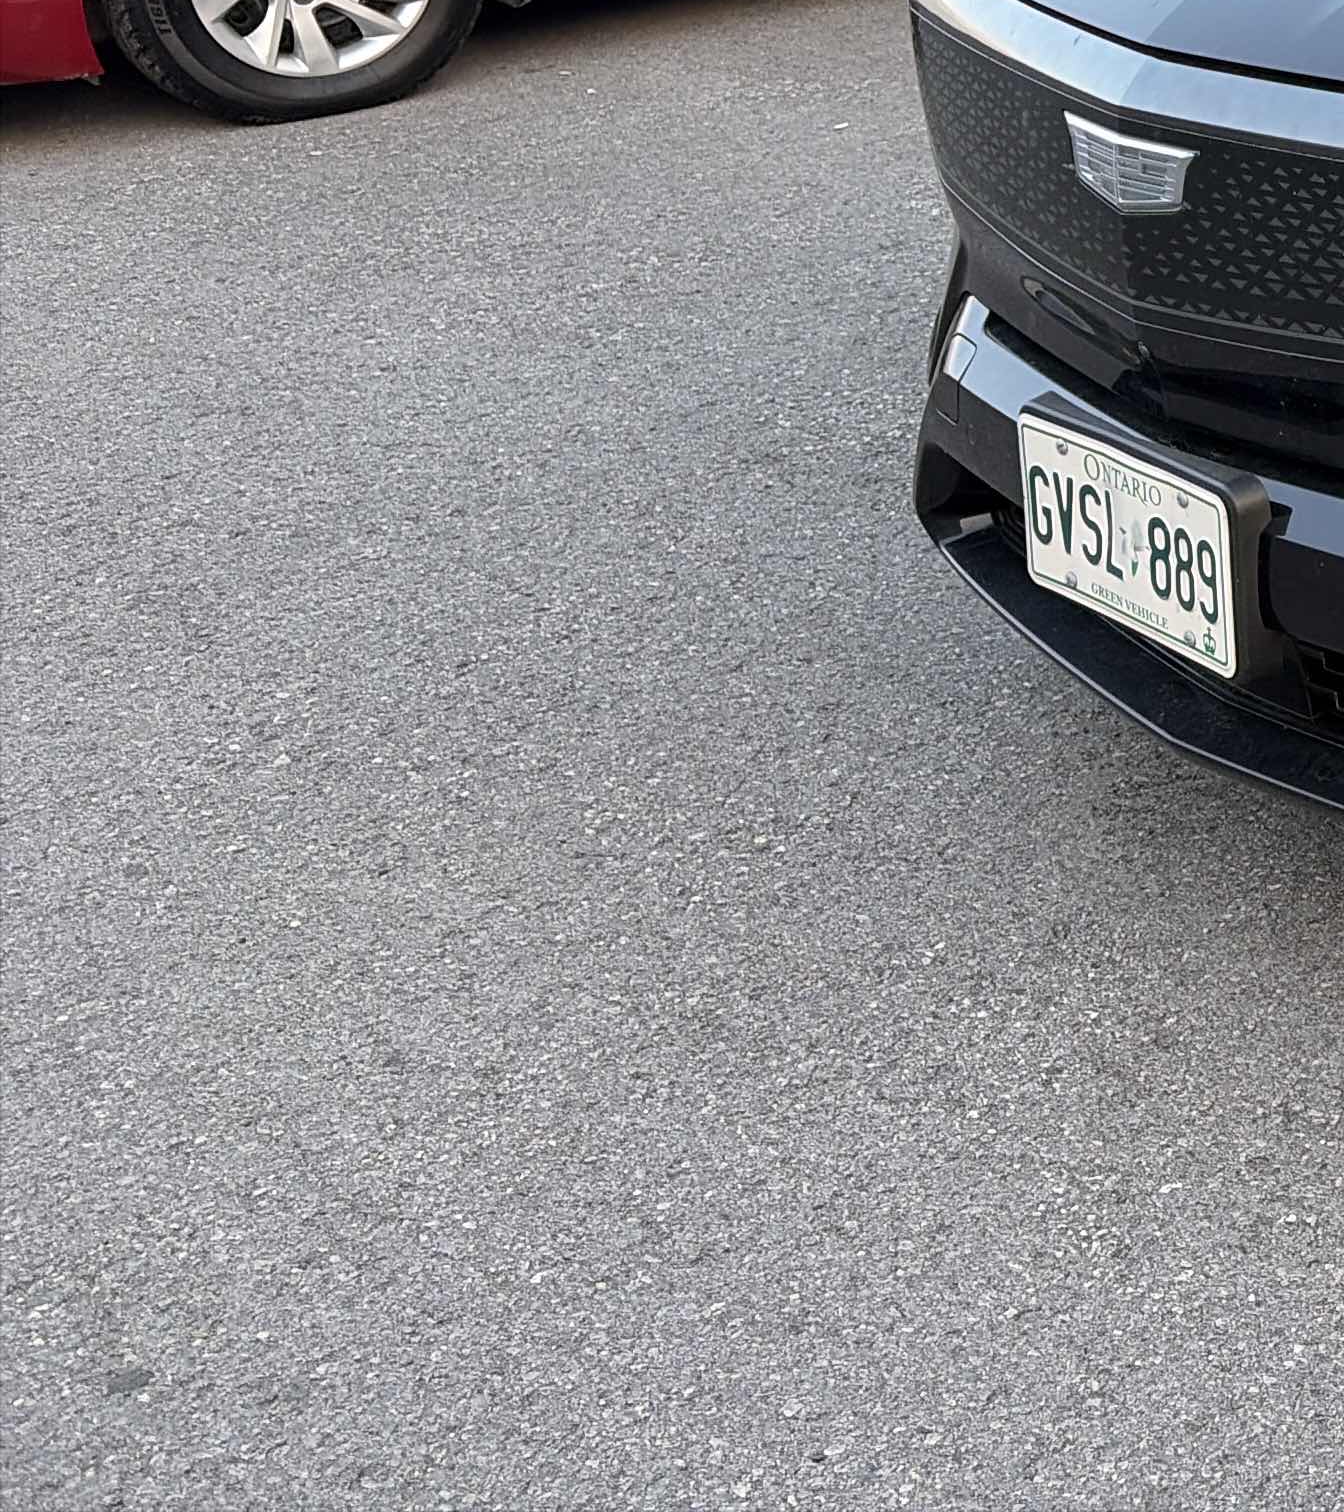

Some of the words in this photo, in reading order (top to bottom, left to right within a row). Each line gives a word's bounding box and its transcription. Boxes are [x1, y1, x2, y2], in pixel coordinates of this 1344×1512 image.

[1084, 453, 1162, 506] ONTARIO
[1029, 465, 1124, 581] GVSL
[1148, 517, 1219, 625] 889
[1091, 582, 1123, 608] GREEN
[1124, 599, 1169, 629] VEHICLE
